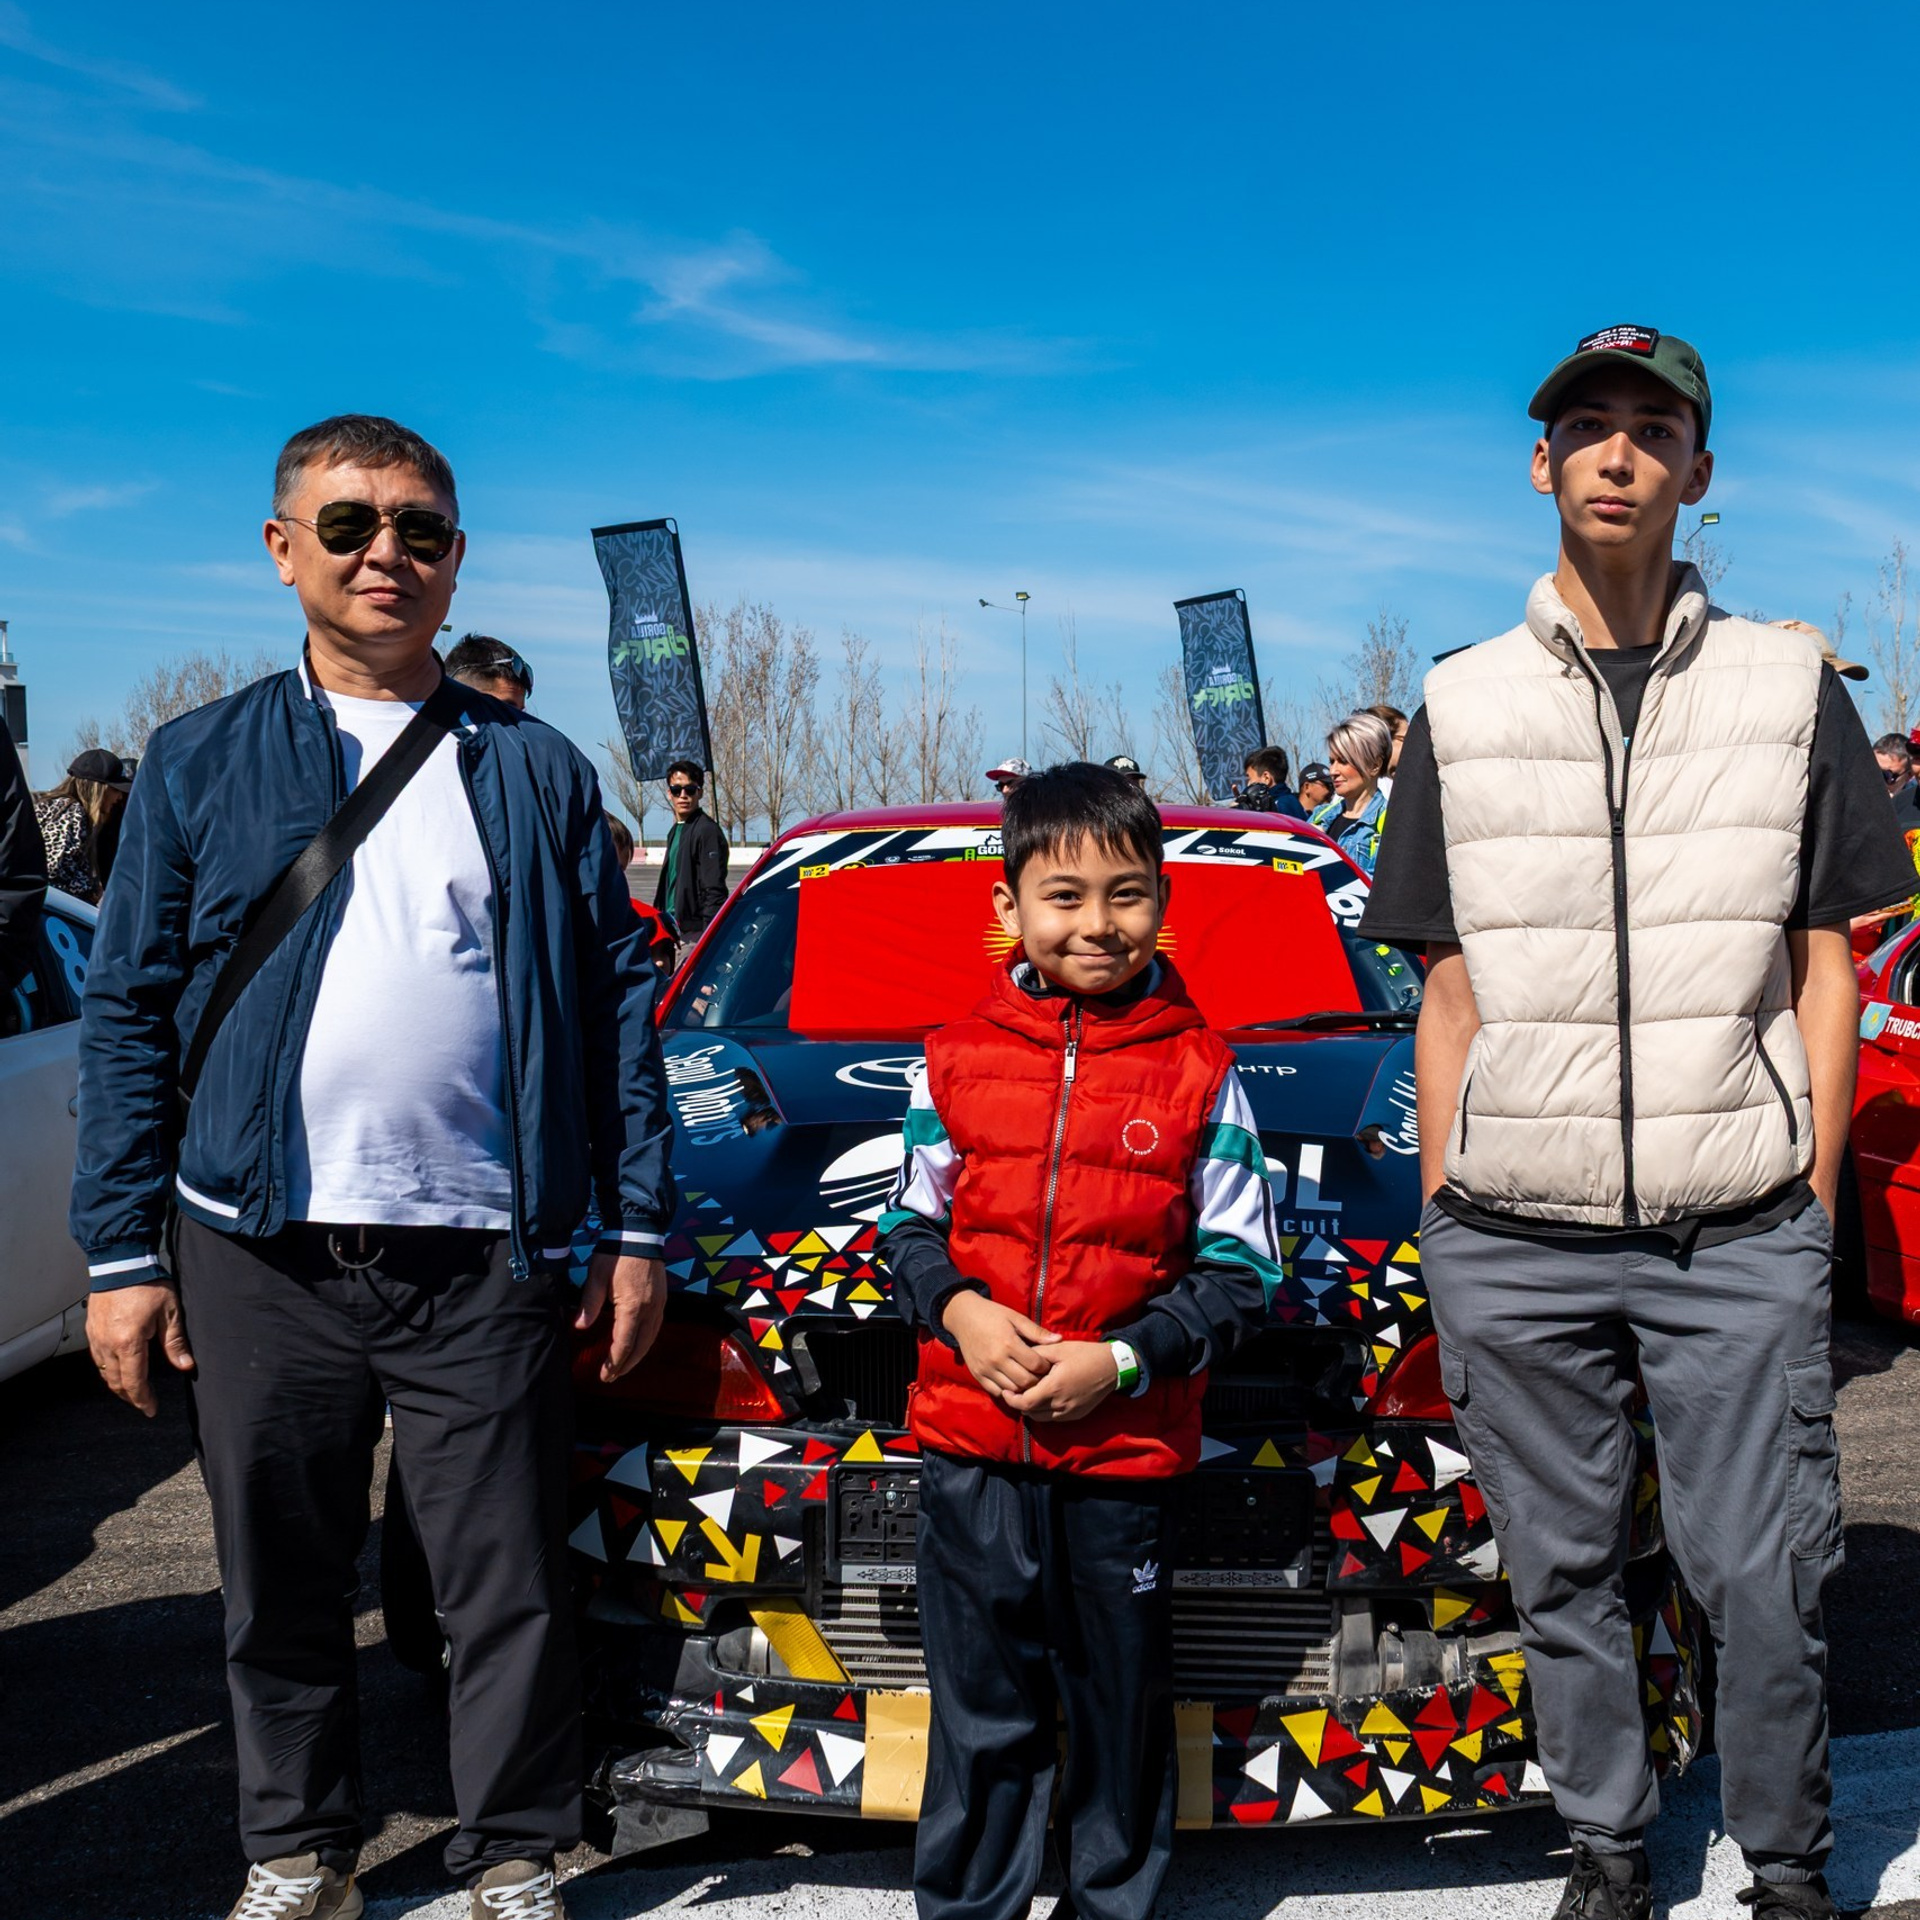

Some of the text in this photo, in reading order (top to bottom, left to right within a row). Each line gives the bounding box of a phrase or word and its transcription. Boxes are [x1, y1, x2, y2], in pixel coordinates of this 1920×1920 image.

[1885, 1016, 1920, 1040] TRUBC
[663, 1045, 745, 1146] Seoul Motors
[1282, 1217, 1341, 1236] cuit
